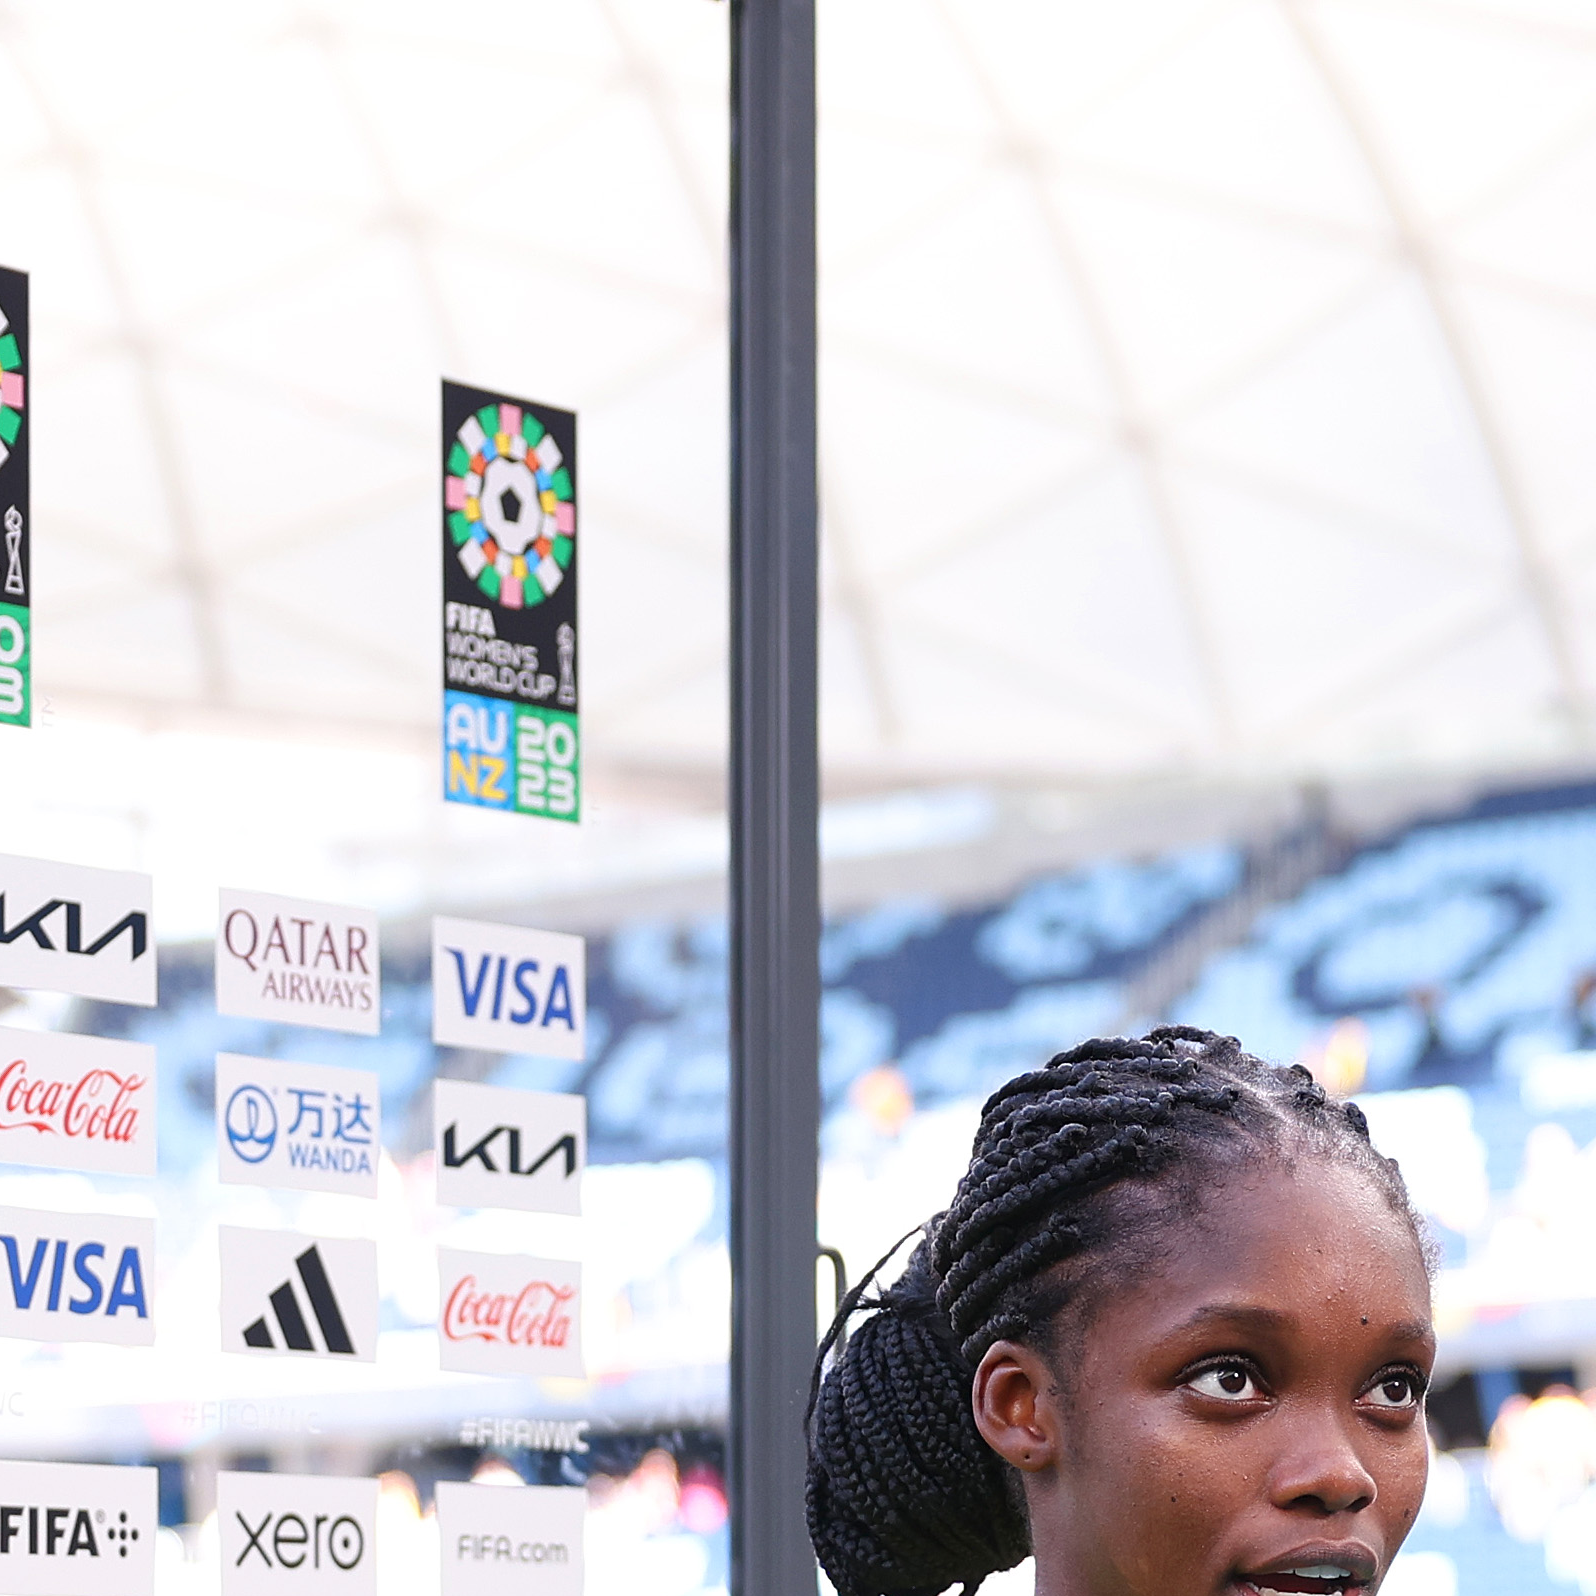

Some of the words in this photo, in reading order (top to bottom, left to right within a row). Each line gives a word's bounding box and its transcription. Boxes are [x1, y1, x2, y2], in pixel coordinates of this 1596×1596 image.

[445, 600, 496, 638] FIFA
[446, 630, 539, 672] WOMEN'S
[446, 656, 517, 694] WORLD
[516, 670, 557, 700] CUP
[447, 702, 508, 755] AU
[516, 715, 576, 768] 20
[449, 748, 508, 802] NZ
[517, 762, 576, 814] 23
[224, 908, 371, 975] QATAR
[261, 971, 373, 1013] AIRWAYS
[442, 945, 576, 1031] VISA
[287, 1087, 373, 1145] 万达
[288, 1142, 373, 1176] WANDA
[236, 1510, 364, 1570] xero
[458, 1533, 569, 1566] FIFA.com
